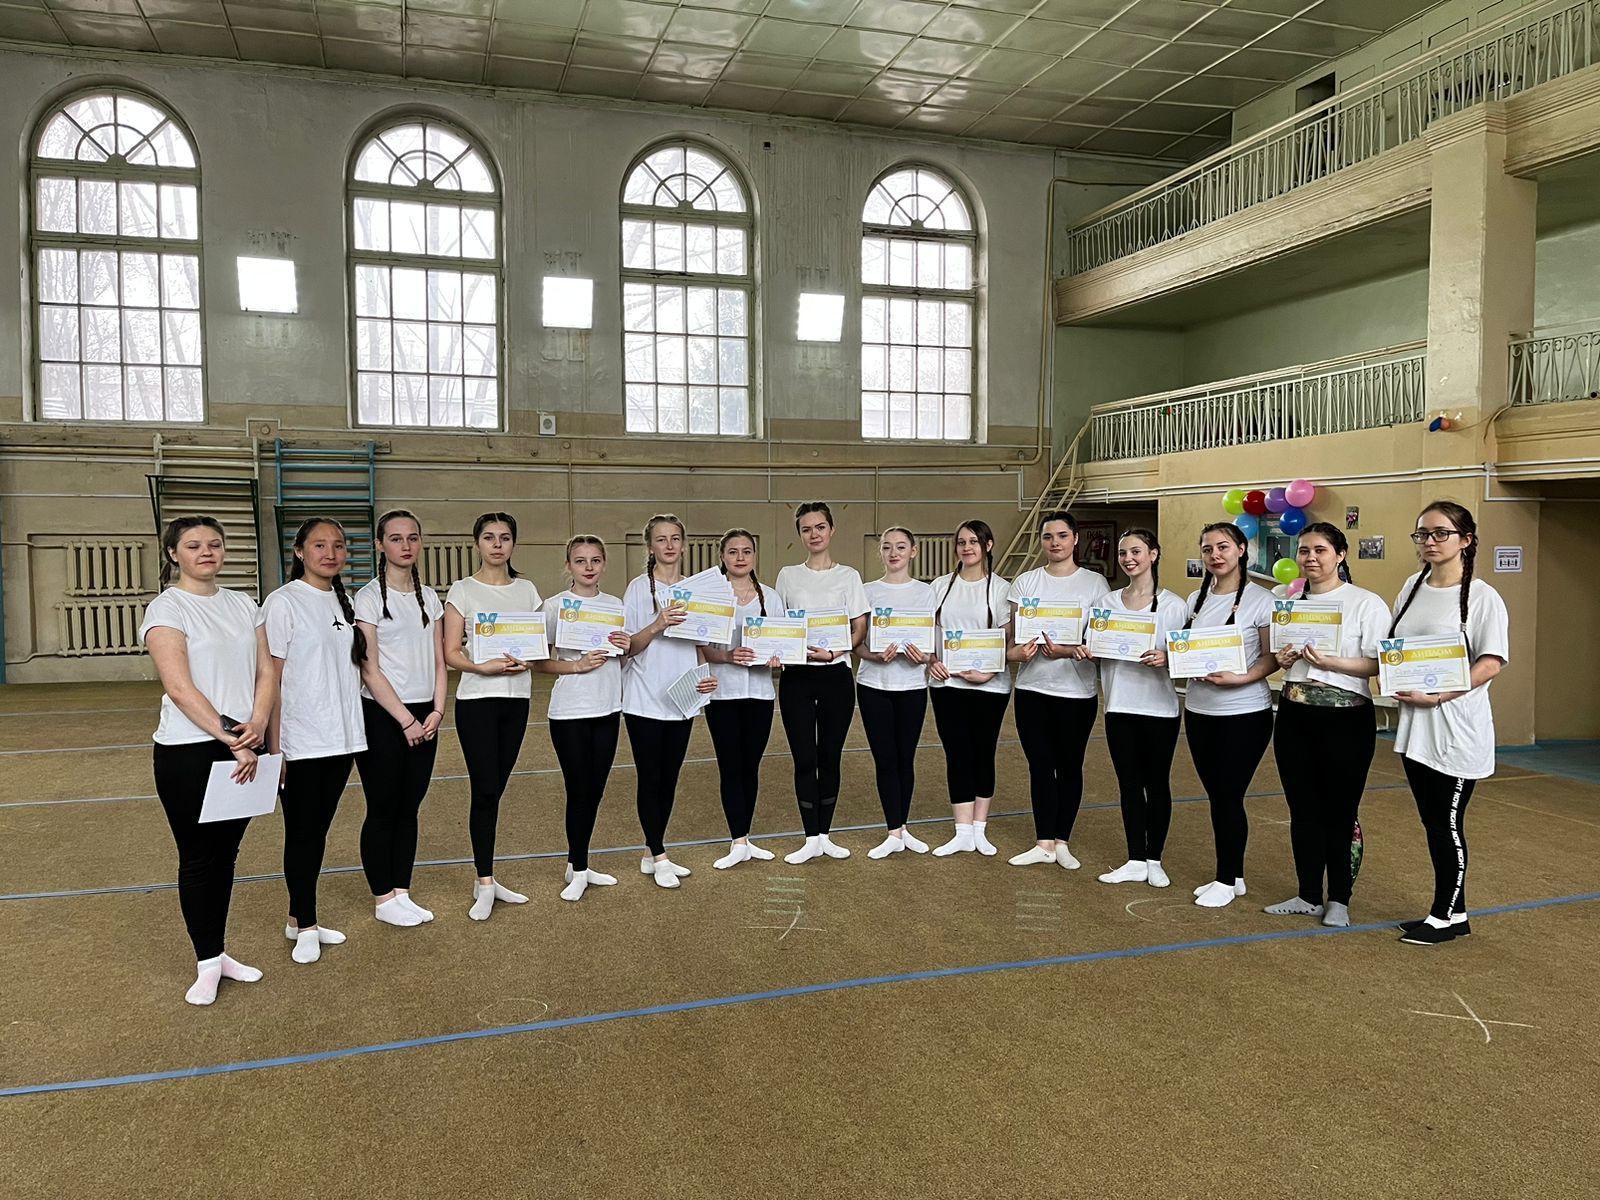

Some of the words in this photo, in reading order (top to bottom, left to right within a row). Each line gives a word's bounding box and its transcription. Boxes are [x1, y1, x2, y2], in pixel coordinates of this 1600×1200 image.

[1455, 778, 1464, 791] GHT
[1452, 791, 1461, 808] NOW
[1451, 830, 1462, 847] NOW
[1456, 848, 1465, 869] RIGHT
[1456, 870, 1464, 887] NOW
